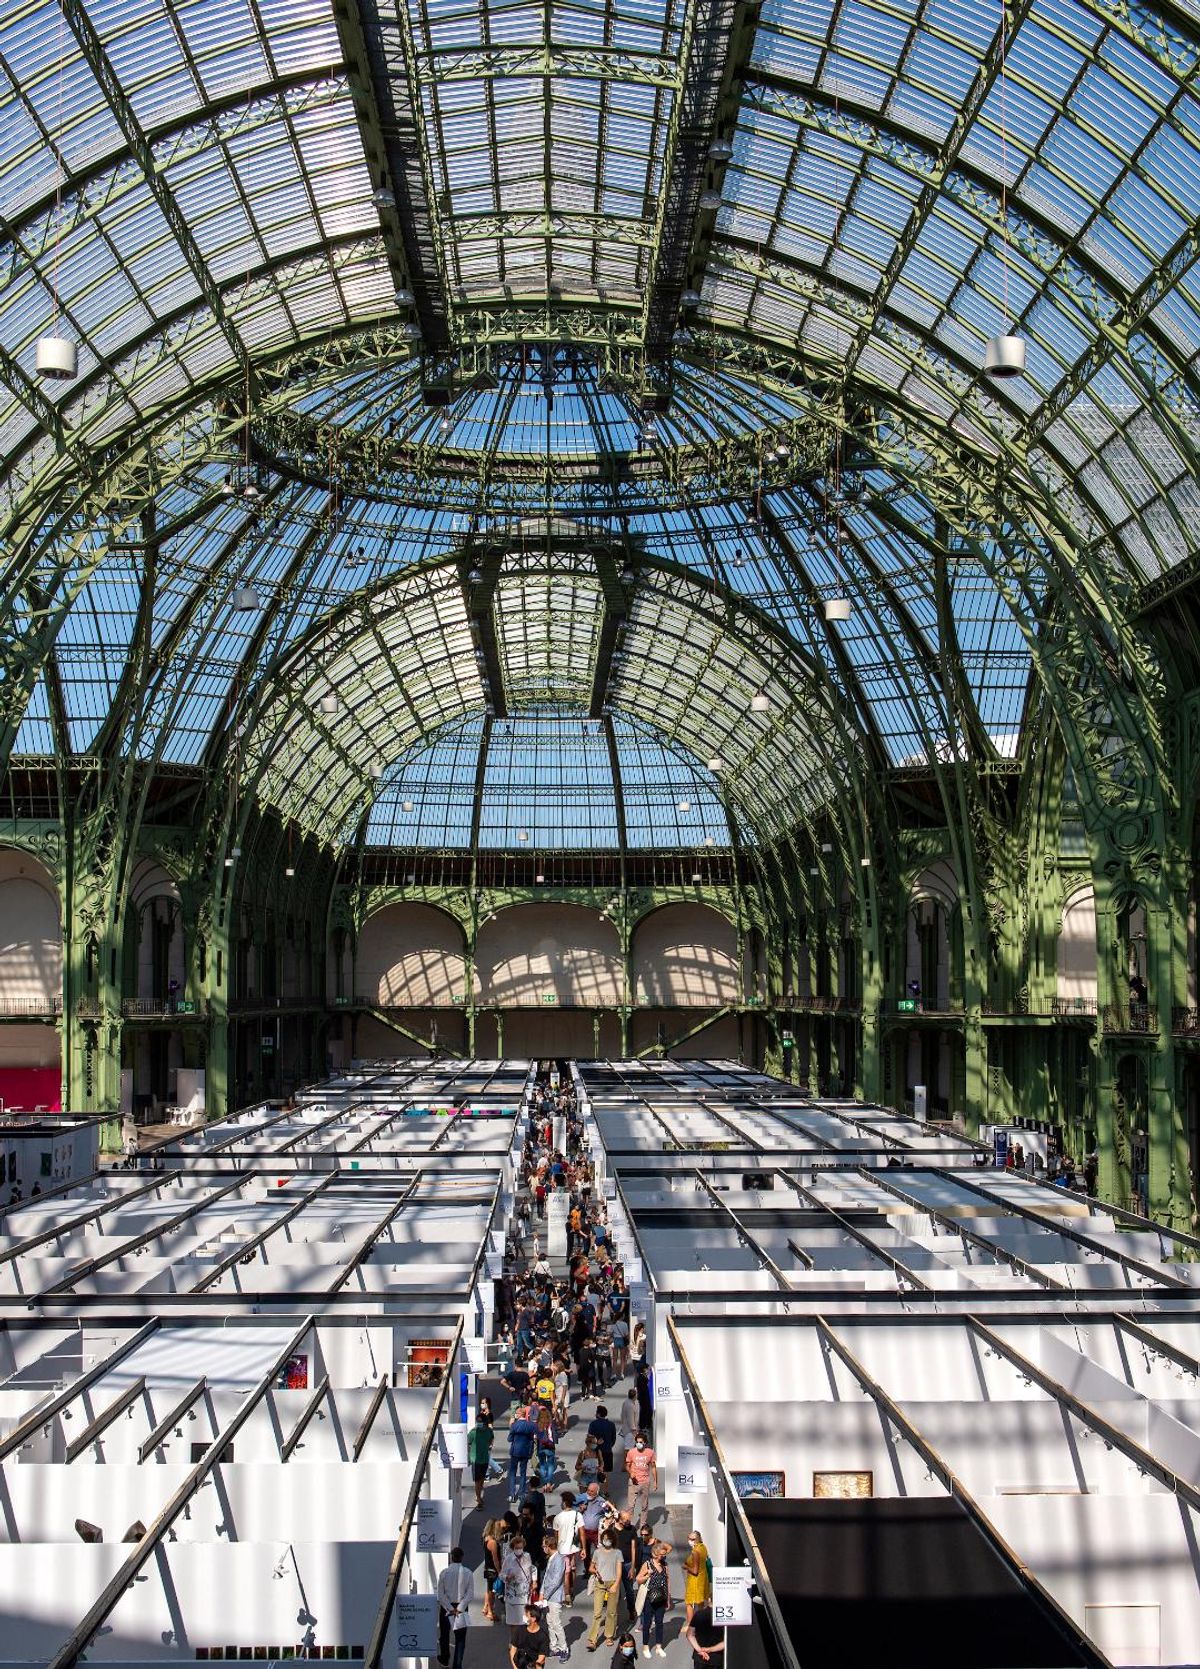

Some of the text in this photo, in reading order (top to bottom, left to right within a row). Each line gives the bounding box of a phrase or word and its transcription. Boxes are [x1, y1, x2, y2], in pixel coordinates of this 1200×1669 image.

[658, 1386, 671, 1396] B5
[678, 1474, 694, 1484] B4
[419, 1533, 436, 1544] C4
[715, 1606, 734, 1618] B3
[398, 1634, 418, 1647] C3
